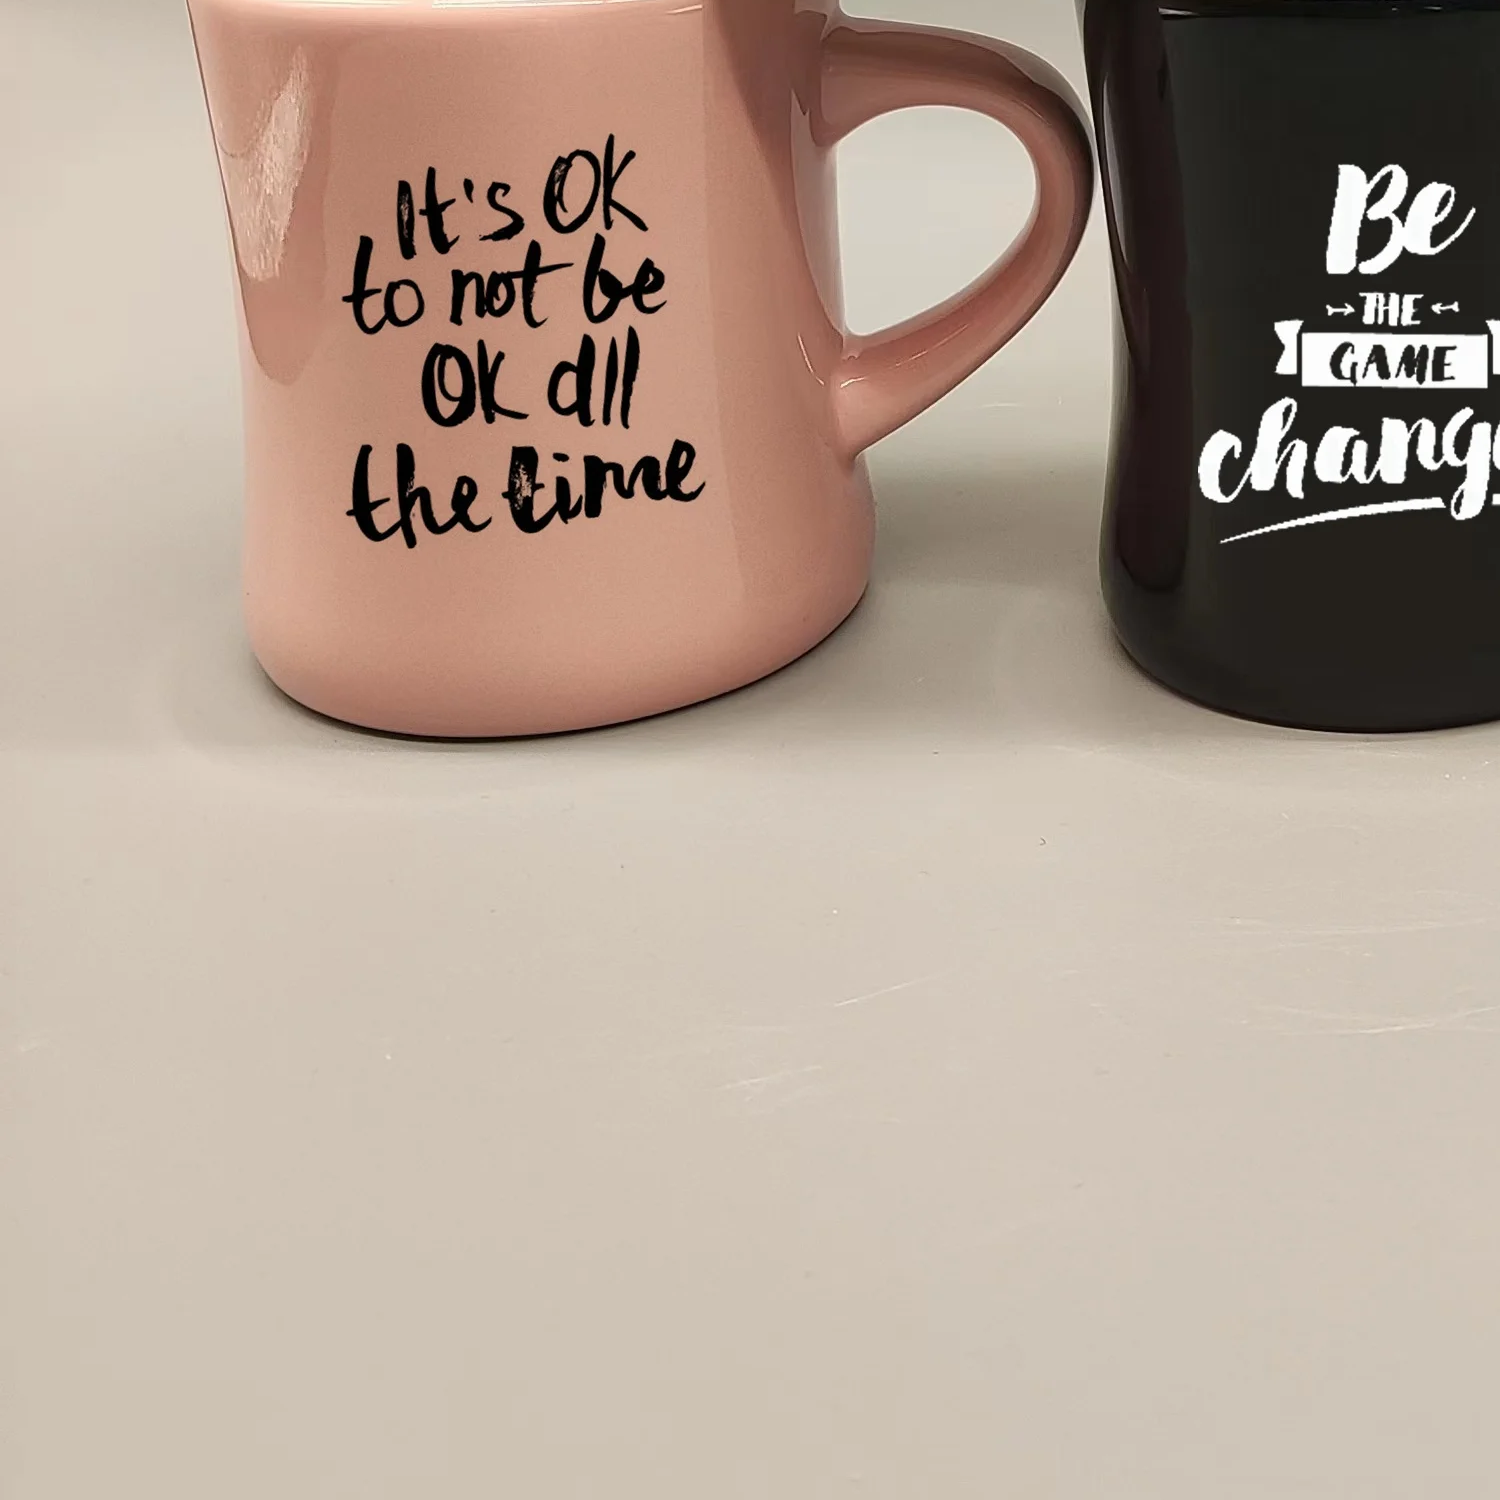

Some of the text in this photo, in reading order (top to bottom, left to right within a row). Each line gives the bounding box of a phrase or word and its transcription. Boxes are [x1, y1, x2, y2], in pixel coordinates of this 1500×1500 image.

[396, 166, 525, 259] It's
[1326, 164, 1476, 275] Be
[342, 232, 667, 335] to not be
[1359, 292, 1424, 326] THE
[1329, 341, 1458, 386] GAME
[346, 439, 706, 549] the time
